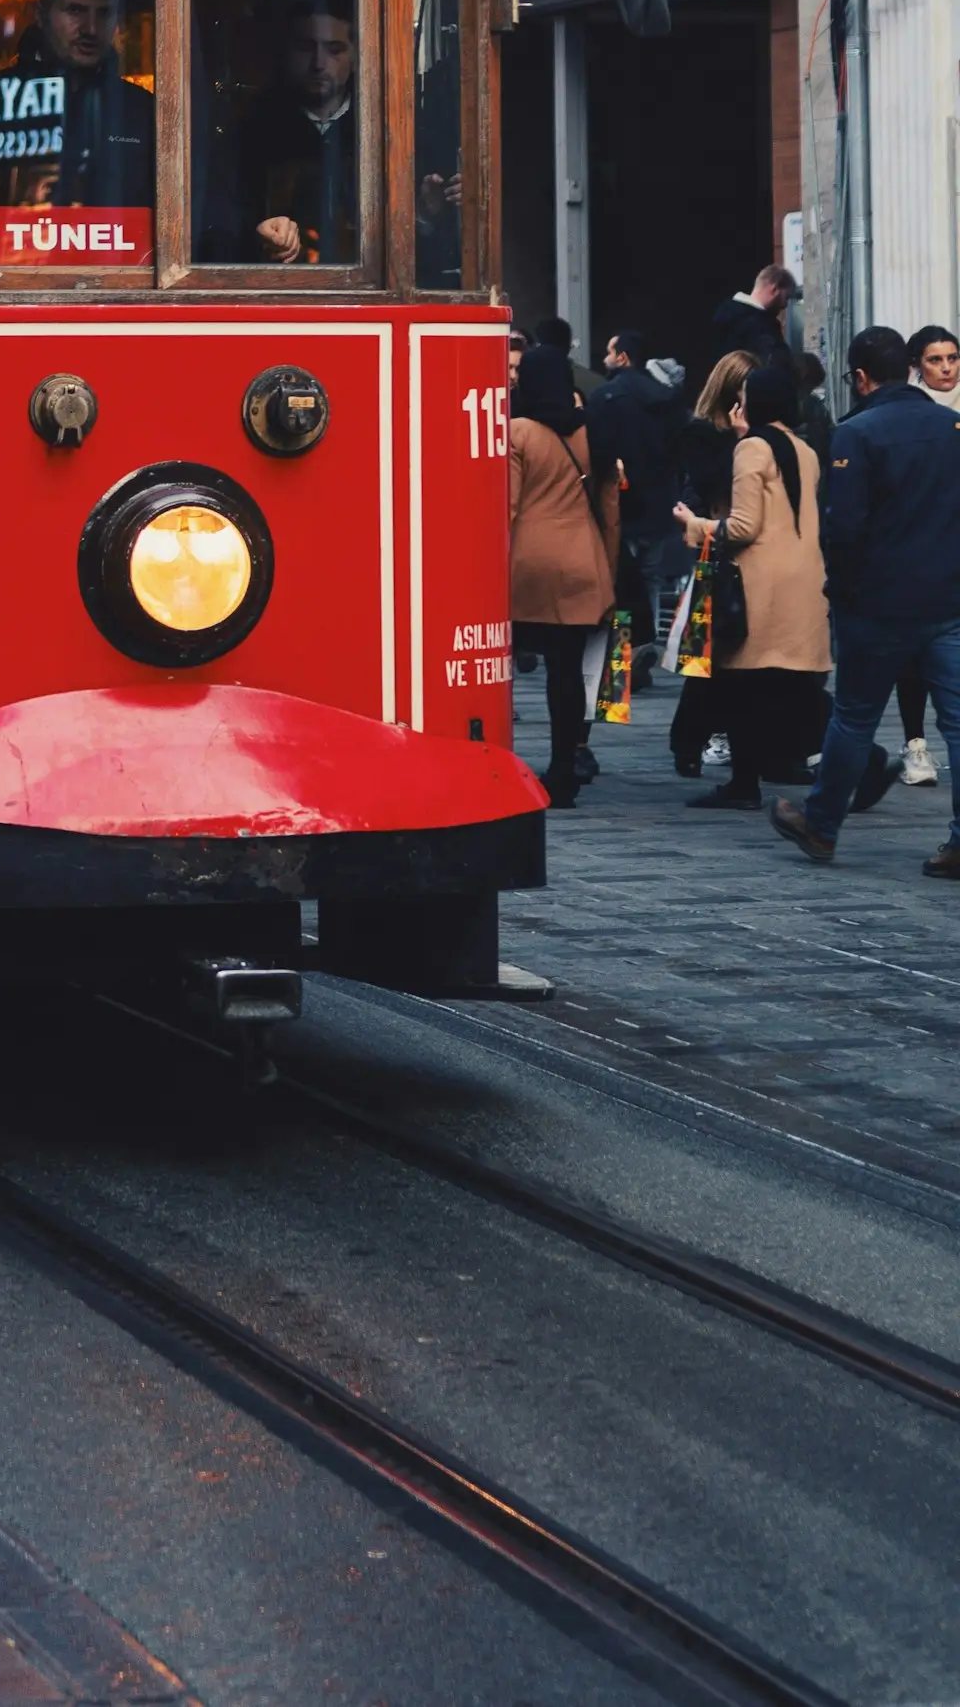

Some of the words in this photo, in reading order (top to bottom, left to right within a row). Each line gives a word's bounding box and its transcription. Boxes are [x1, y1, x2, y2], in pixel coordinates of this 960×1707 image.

[5, 217, 136, 251] TÜNEL
[462, 386, 507, 459] 115
[445, 658, 468, 688] VE
